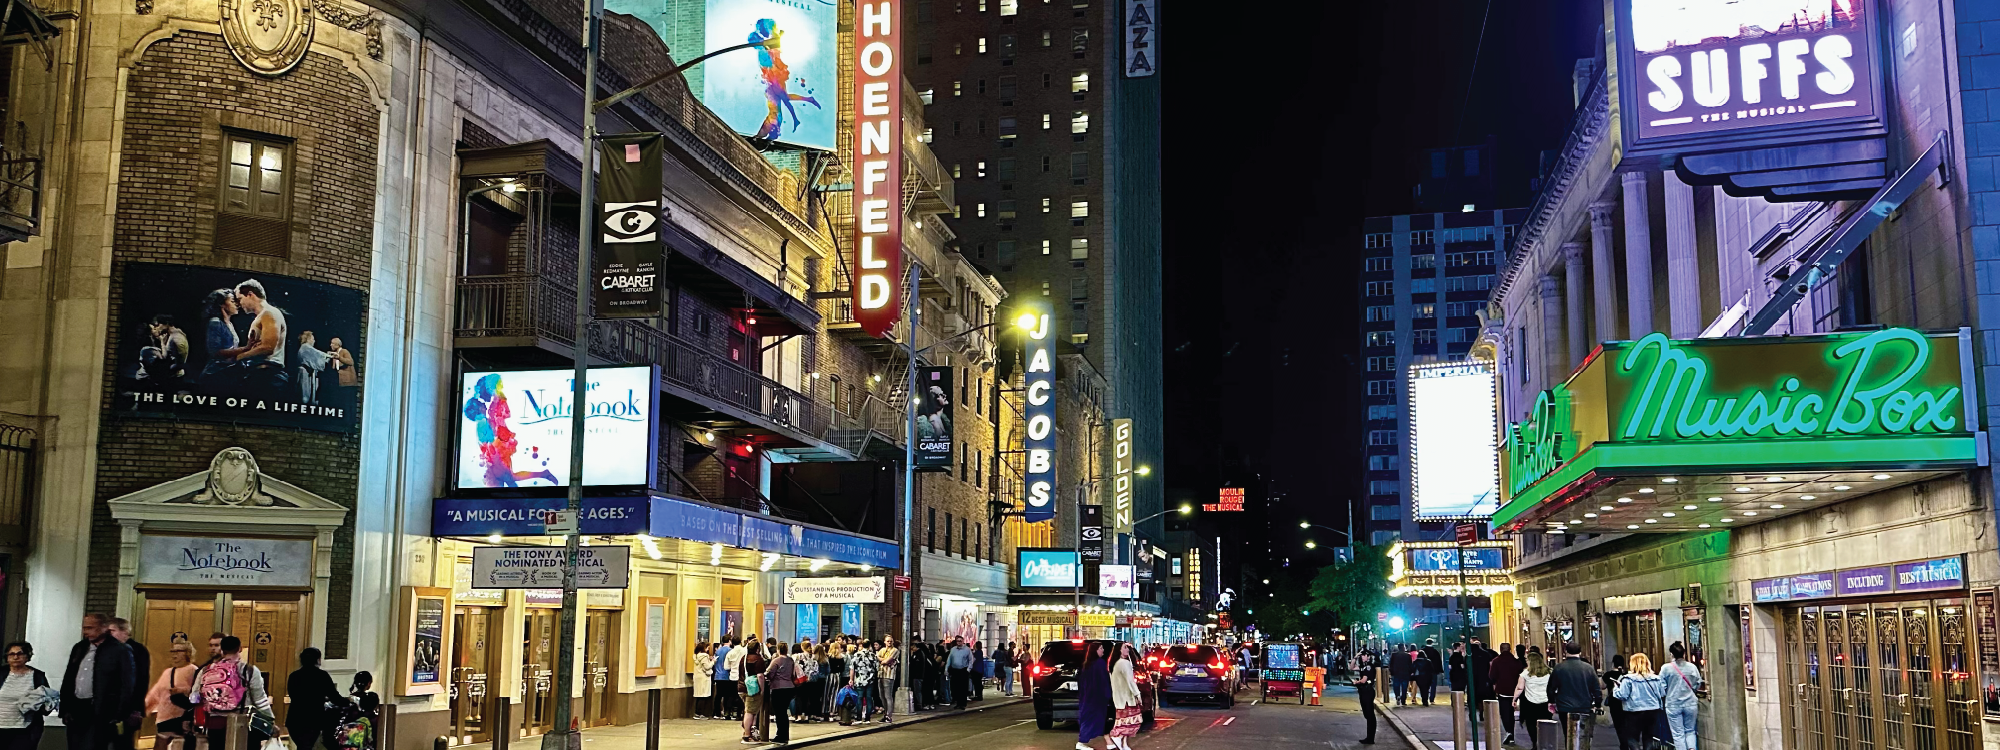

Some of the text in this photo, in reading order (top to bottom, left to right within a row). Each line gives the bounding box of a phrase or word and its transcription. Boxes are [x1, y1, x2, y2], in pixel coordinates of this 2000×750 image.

[1646, 34, 1856, 113] SUFFS
[1701, 105, 1806, 123] THE MUSICAL
[601, 274, 656, 289] CABARET
[1418, 365, 1484, 379] IMPERIAL
[1624, 328, 1960, 437] Music Box
[133, 392, 344, 418] THE LOVE OF A LIFETIME
[1027, 313, 1052, 507] JACOBS
[920, 442, 951, 451] CABARET
[1116, 422, 1129, 529] GOLDEN
[1219, 487, 1245, 496] MOULIN
[466, 508, 525, 522] MUSICAL
[1202, 503, 1245, 512] THE MUSICAL
[680, 514, 706, 531] BASED
[709, 519, 721, 532] ON
[722, 521, 737, 536] THE
[756, 529, 783, 544] SELLING
[806, 537, 821, 550] THAT
[822, 540, 846, 554] INSPIRED
[846, 544, 856, 556] THE
[857, 546, 875, 559] ICONIC
[875, 548, 887, 560] FILM
[214, 542, 242, 553] The
[503, 550, 520, 559] THE
[524, 550, 551, 558] TONY
[181, 547, 272, 570] Notebook
[495, 558, 605, 568] NOMINATED MSICAL
[1847, 575, 1884, 589] INCLUDING
[1899, 570, 1921, 585] BEST
[1922, 566, 1960, 583] MUSICAL
[1021, 611, 1032, 624] 12
[1031, 616, 1045, 624] BEST
[1047, 616, 1072, 624] MUSICAL
